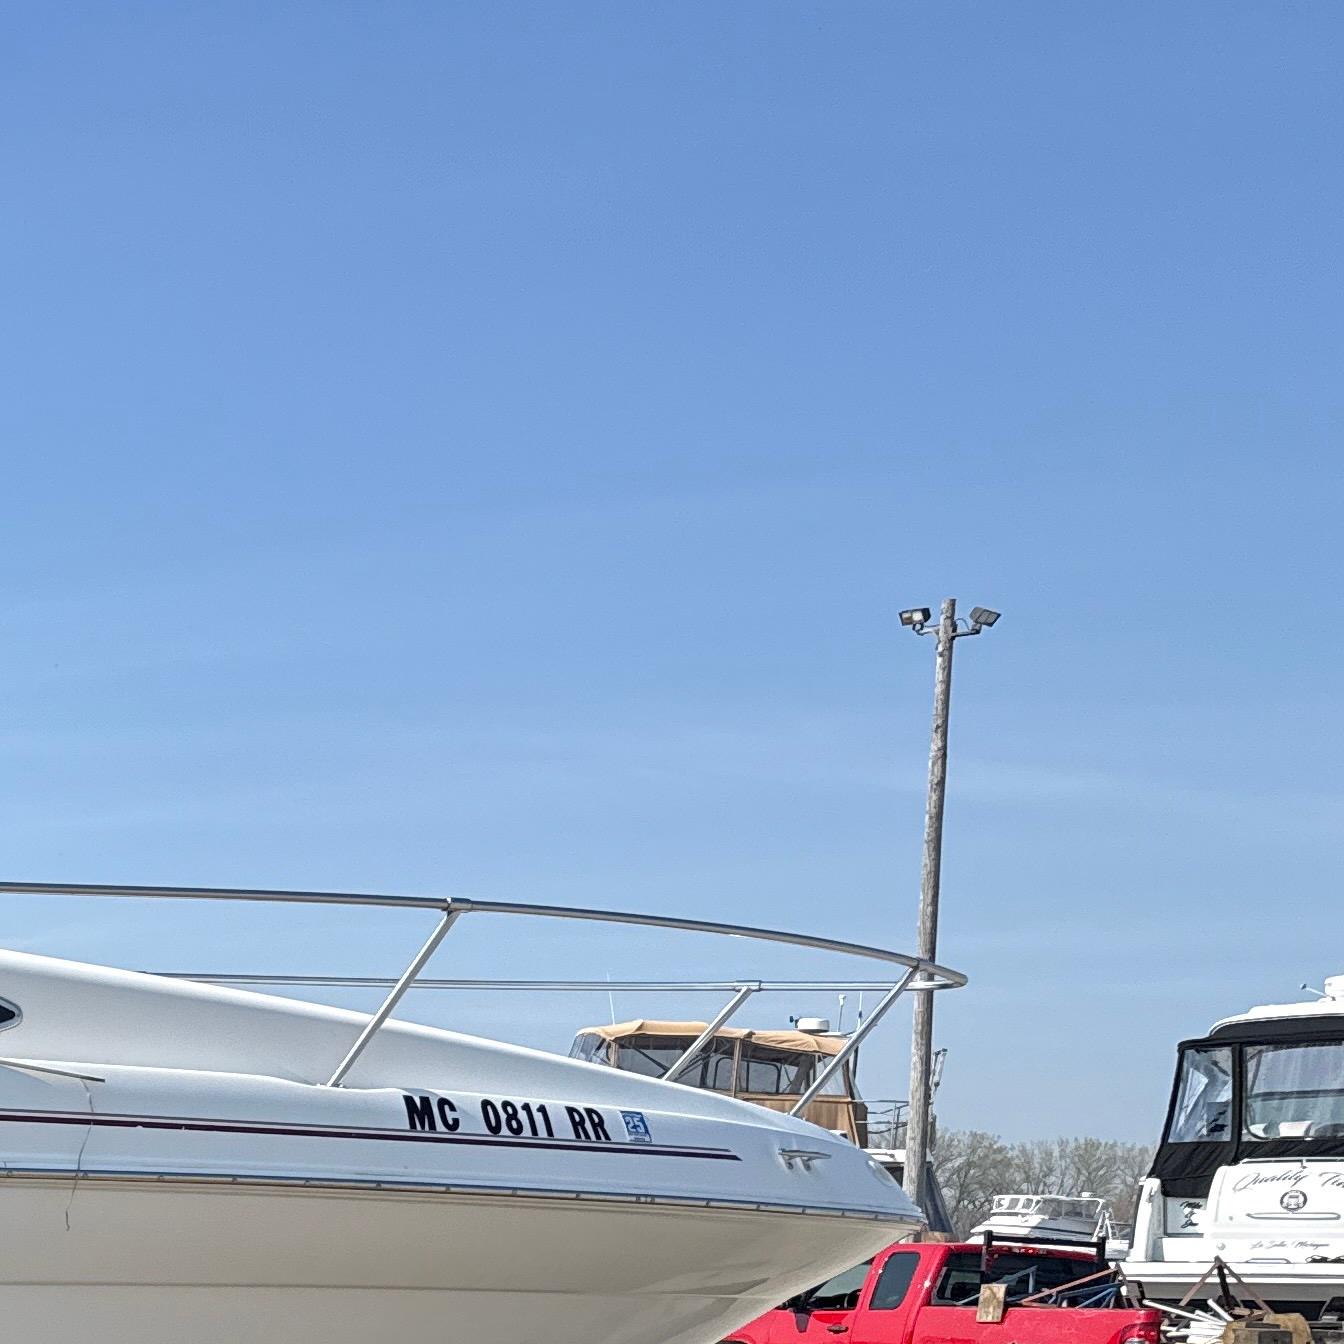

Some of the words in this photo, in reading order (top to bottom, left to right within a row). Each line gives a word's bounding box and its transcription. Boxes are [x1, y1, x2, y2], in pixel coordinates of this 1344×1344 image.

[403, 1095, 460, 1132] MC
[480, 1098, 555, 1138] 0811
[565, 1105, 612, 1141] RR
[624, 1116, 646, 1132] 25
